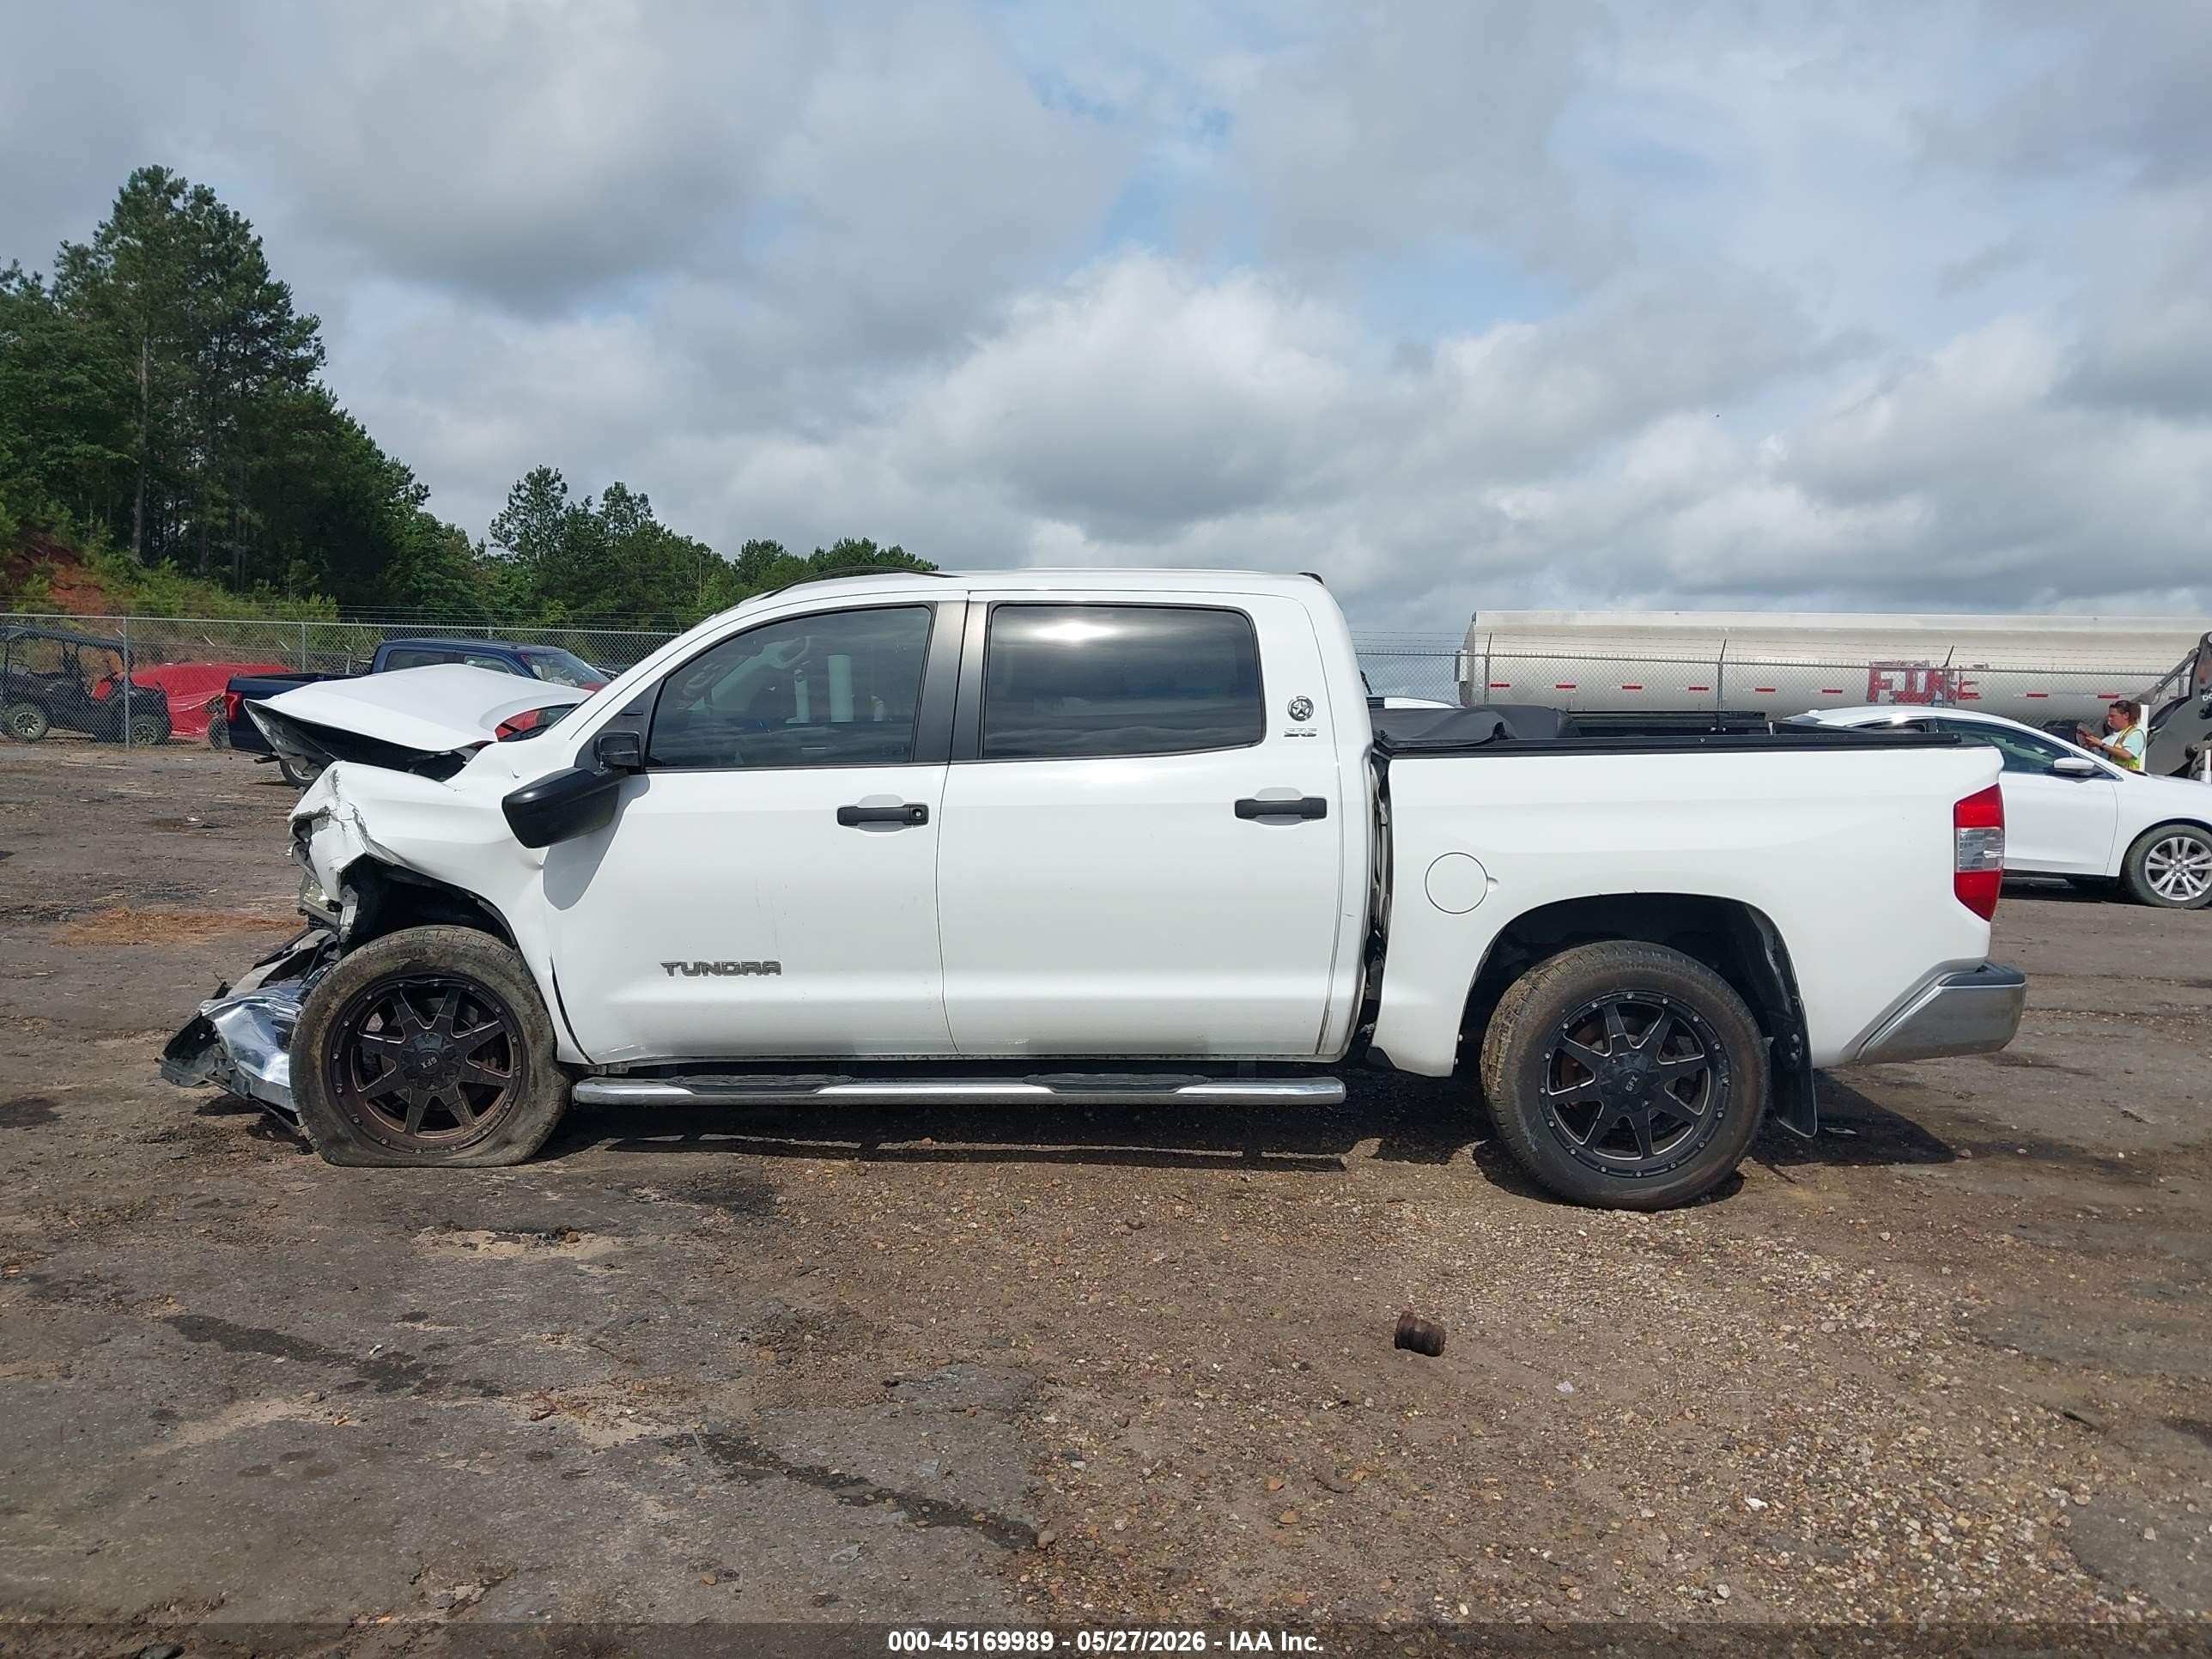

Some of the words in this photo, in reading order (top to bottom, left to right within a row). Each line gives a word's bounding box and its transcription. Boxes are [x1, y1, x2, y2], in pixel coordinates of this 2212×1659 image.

[659, 961, 782, 976] TUNDRA
[421, 1056, 437, 1070] GFX
[1625, 1074, 1639, 1091] GFX
